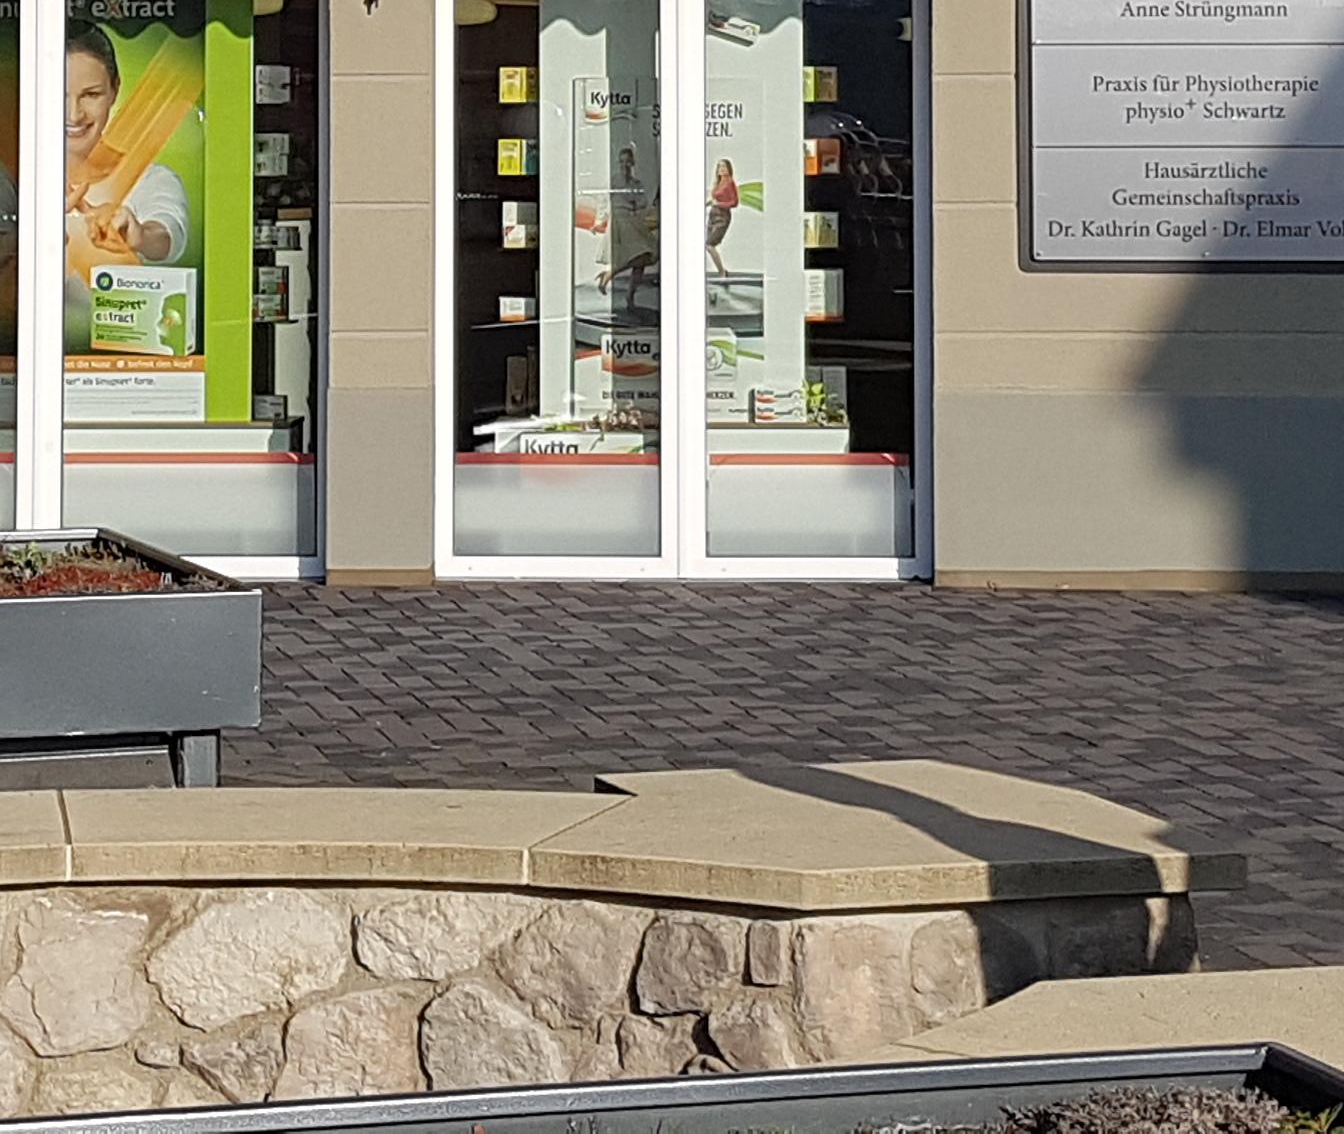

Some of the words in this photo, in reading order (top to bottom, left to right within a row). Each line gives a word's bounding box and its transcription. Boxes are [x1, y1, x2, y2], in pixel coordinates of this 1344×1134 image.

[1120, 2, 1169, 18] Anne
[1175, 1, 1288, 23] Strüngmann
[1092, 76, 1148, 92] Praxis
[1153, 76, 1181, 92] für
[1186, 76, 1320, 97] Physiotherapie
[590, 92, 632, 107] Kytta
[1203, 103, 1286, 120] Schwartz
[1144, 162, 1268, 179] Hausärztliche
[1112, 189, 1300, 210] Gemeinschaftspraxis
[1048, 221, 1076, 238] Dr.
[1081, 221, 1150, 238] Kathrin
[1156, 221, 1206, 242] Gagel
[1223, 221, 1251, 238] Dr.
[1257, 221, 1311, 238] Elmar
[606, 339, 650, 357] Kytta
